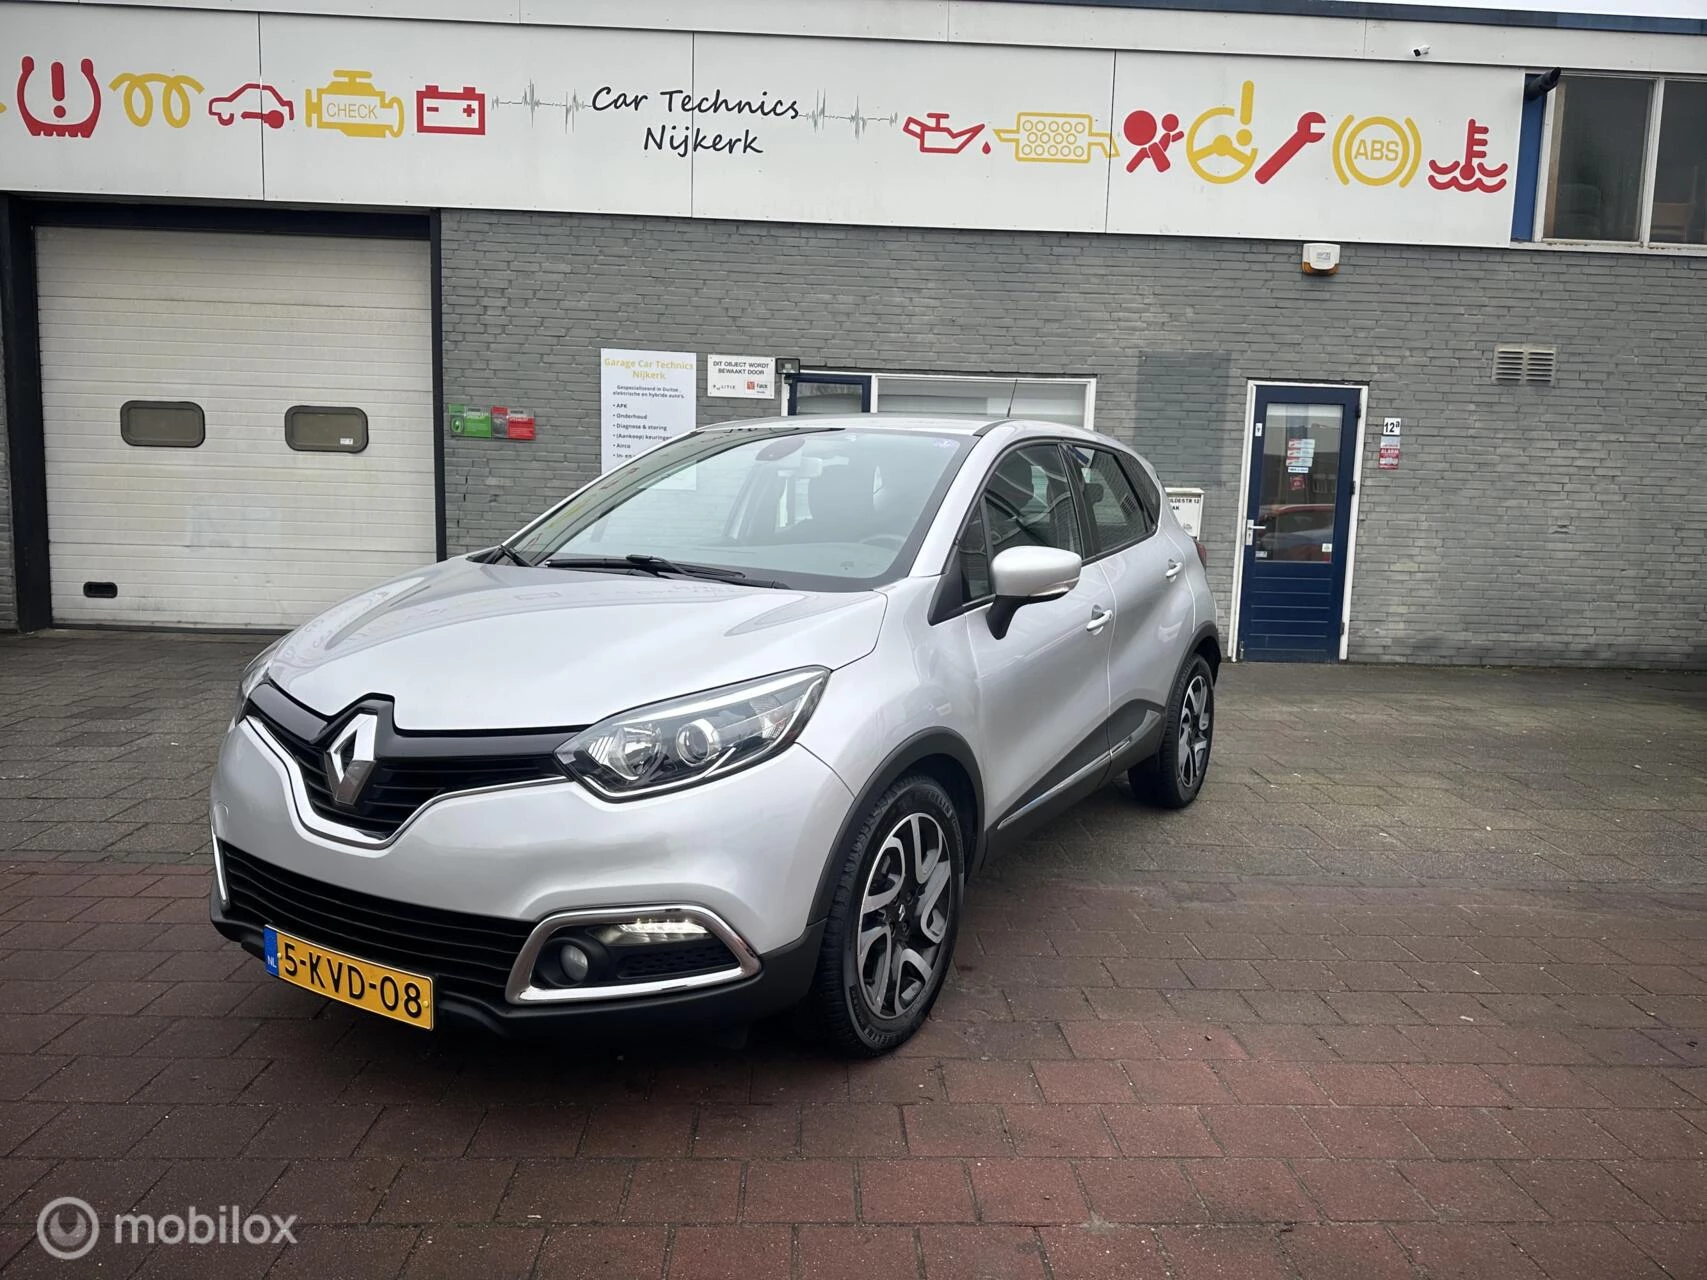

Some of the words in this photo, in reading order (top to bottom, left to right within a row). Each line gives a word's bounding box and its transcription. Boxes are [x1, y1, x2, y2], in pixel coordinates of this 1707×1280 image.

[326, 102, 378, 119] CHECK
[591, 86, 648, 111] Car
[660, 89, 799, 119] Technics
[643, 124, 763, 158] Nijkerk
[1353, 139, 1399, 161] ABS
[604, 358, 636, 369] Garage
[638, 360, 653, 368] Car
[655, 360, 694, 370] Technics
[632, 371, 666, 380] Nijkerk
[267, 955, 277, 969] NL
[283, 942, 422, 1019] 5-KVD-08
